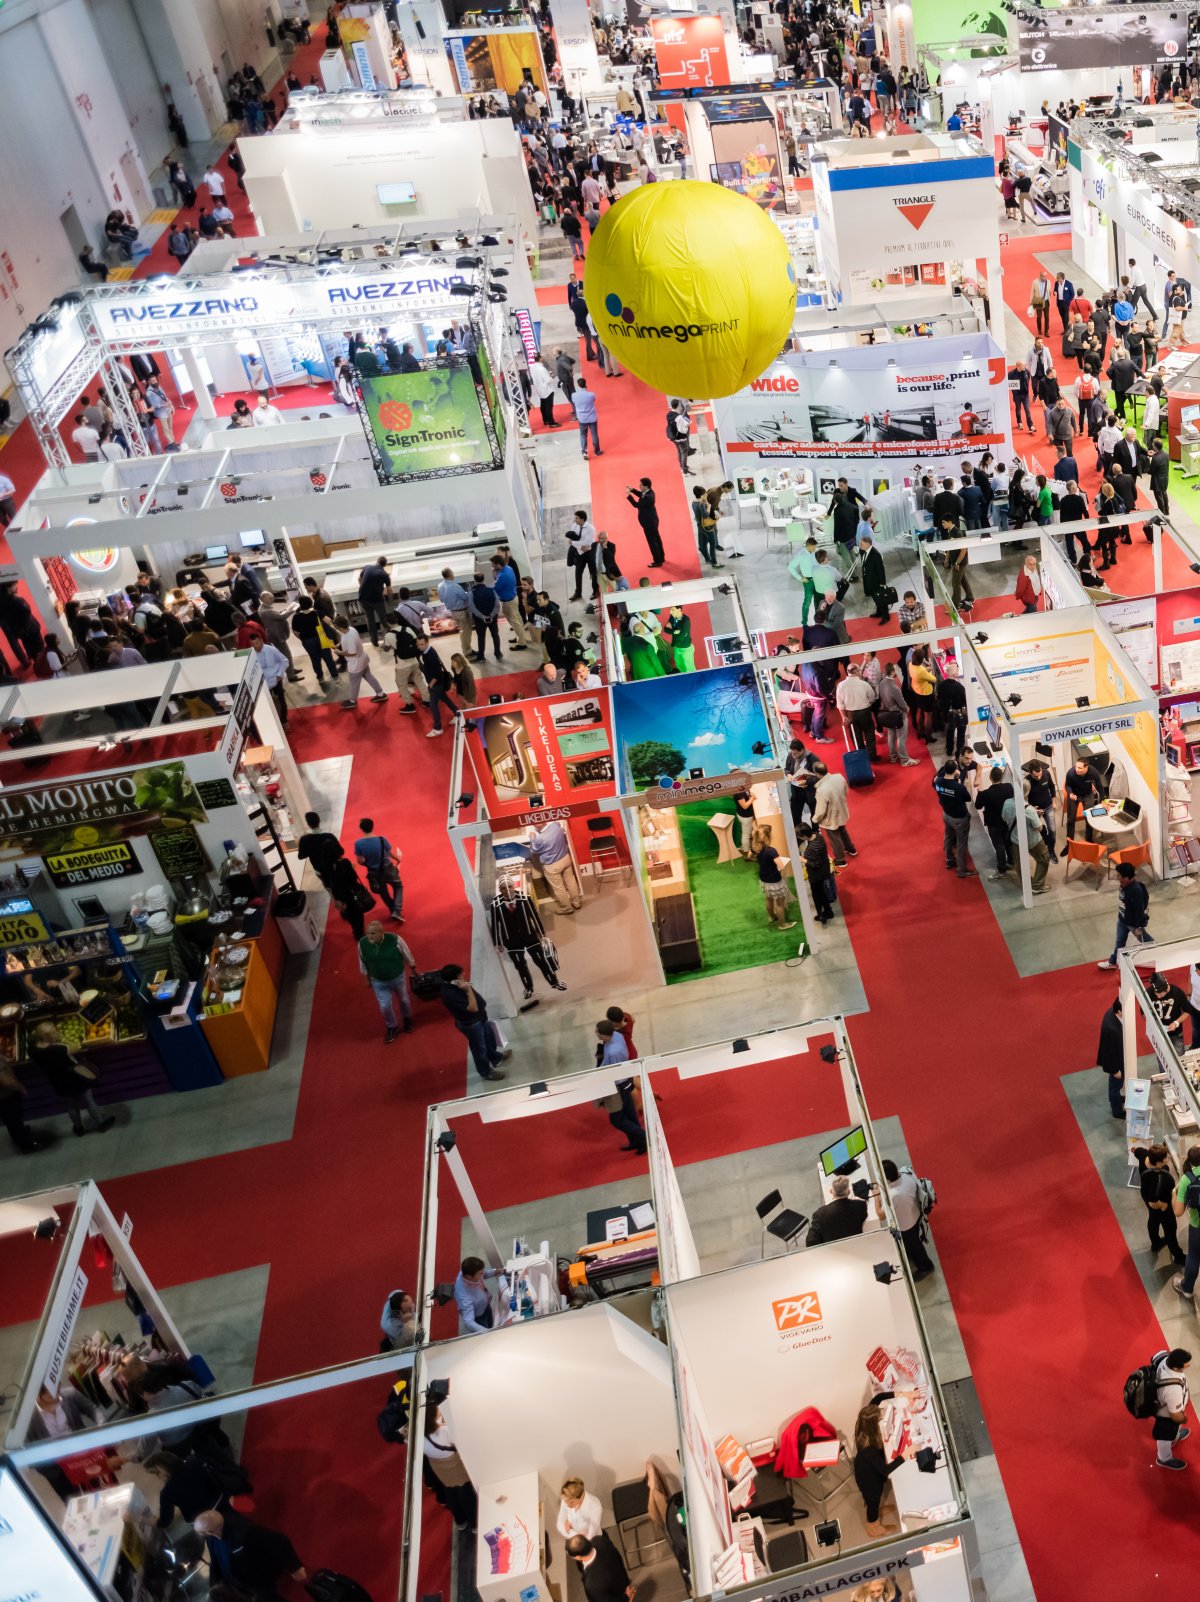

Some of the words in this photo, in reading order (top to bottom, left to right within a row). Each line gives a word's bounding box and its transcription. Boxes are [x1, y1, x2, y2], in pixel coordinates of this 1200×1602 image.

[564, 38, 588, 46] EPSON
[1019, 31, 1045, 39] MUTOH
[357, 46, 376, 91] Summa
[455, 44, 471, 89] Summa
[723, 178, 740, 186] Built
[892, 194, 937, 206] TRIANGLE
[1127, 204, 1177, 251] EUROSCREEN
[328, 275, 465, 303] AVEZZANO
[109, 296, 259, 324] AVEZZANO
[332, 304, 384, 315] SISTEMI
[608, 318, 740, 343] minimegaPRINT
[750, 375, 800, 392] wide
[896, 373, 945, 384] because
[897, 384, 908, 393] is
[910, 385, 931, 393] our
[933, 381, 956, 392] life.
[1044, 723, 1112, 742] DYNAMICSOFT
[1113, 718, 1133, 731] SRL
[534, 706, 563, 792] LIKEIDEAS
[25, 777, 138, 815] MOJITO
[29, 801, 144, 829] HEMINGWAY
[518, 807, 572, 827] LIKEIDEAS
[50, 859, 65, 872] LA
[66, 847, 129, 869] BODEGUITA
[66, 870, 89, 884] DEL
[90, 862, 125, 880] MEDIO
[49, 1275, 85, 1385] BUSTEBIEMME.IT
[780, 1324, 825, 1340] VIGEVANO
[791, 1333, 833, 1350] GlueDots
[885, 1556, 910, 1573] PK
